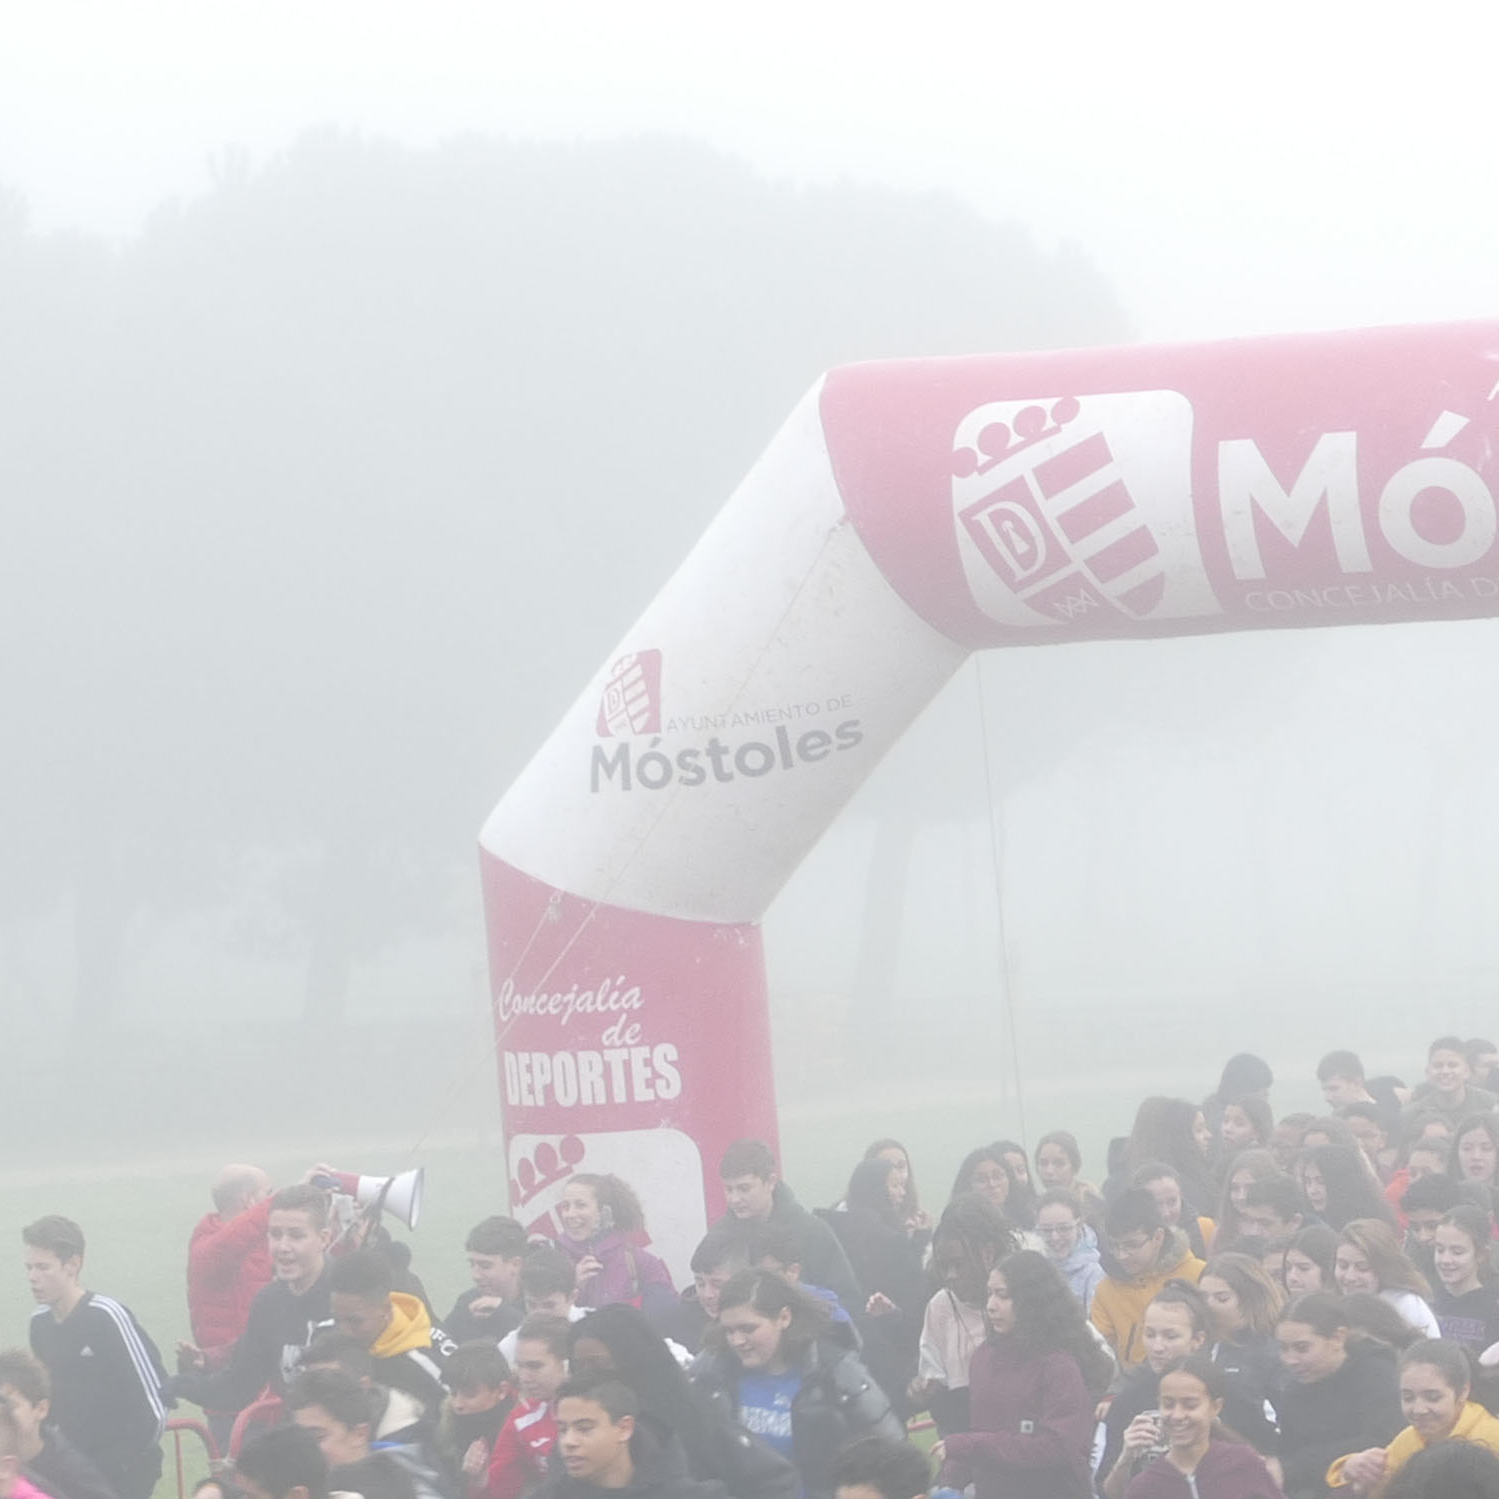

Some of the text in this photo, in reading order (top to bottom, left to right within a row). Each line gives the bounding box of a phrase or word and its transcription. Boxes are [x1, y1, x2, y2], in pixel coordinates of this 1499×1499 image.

[1244, 577, 1459, 613] CONCEJALÍA
[666, 694, 854, 734] AYUNTAMIENTO DE
[589, 718, 863, 793] Móstoles
[499, 974, 646, 1026] Concejalía
[602, 1013, 642, 1046] de
[504, 1042, 682, 1107] DEPORTES
